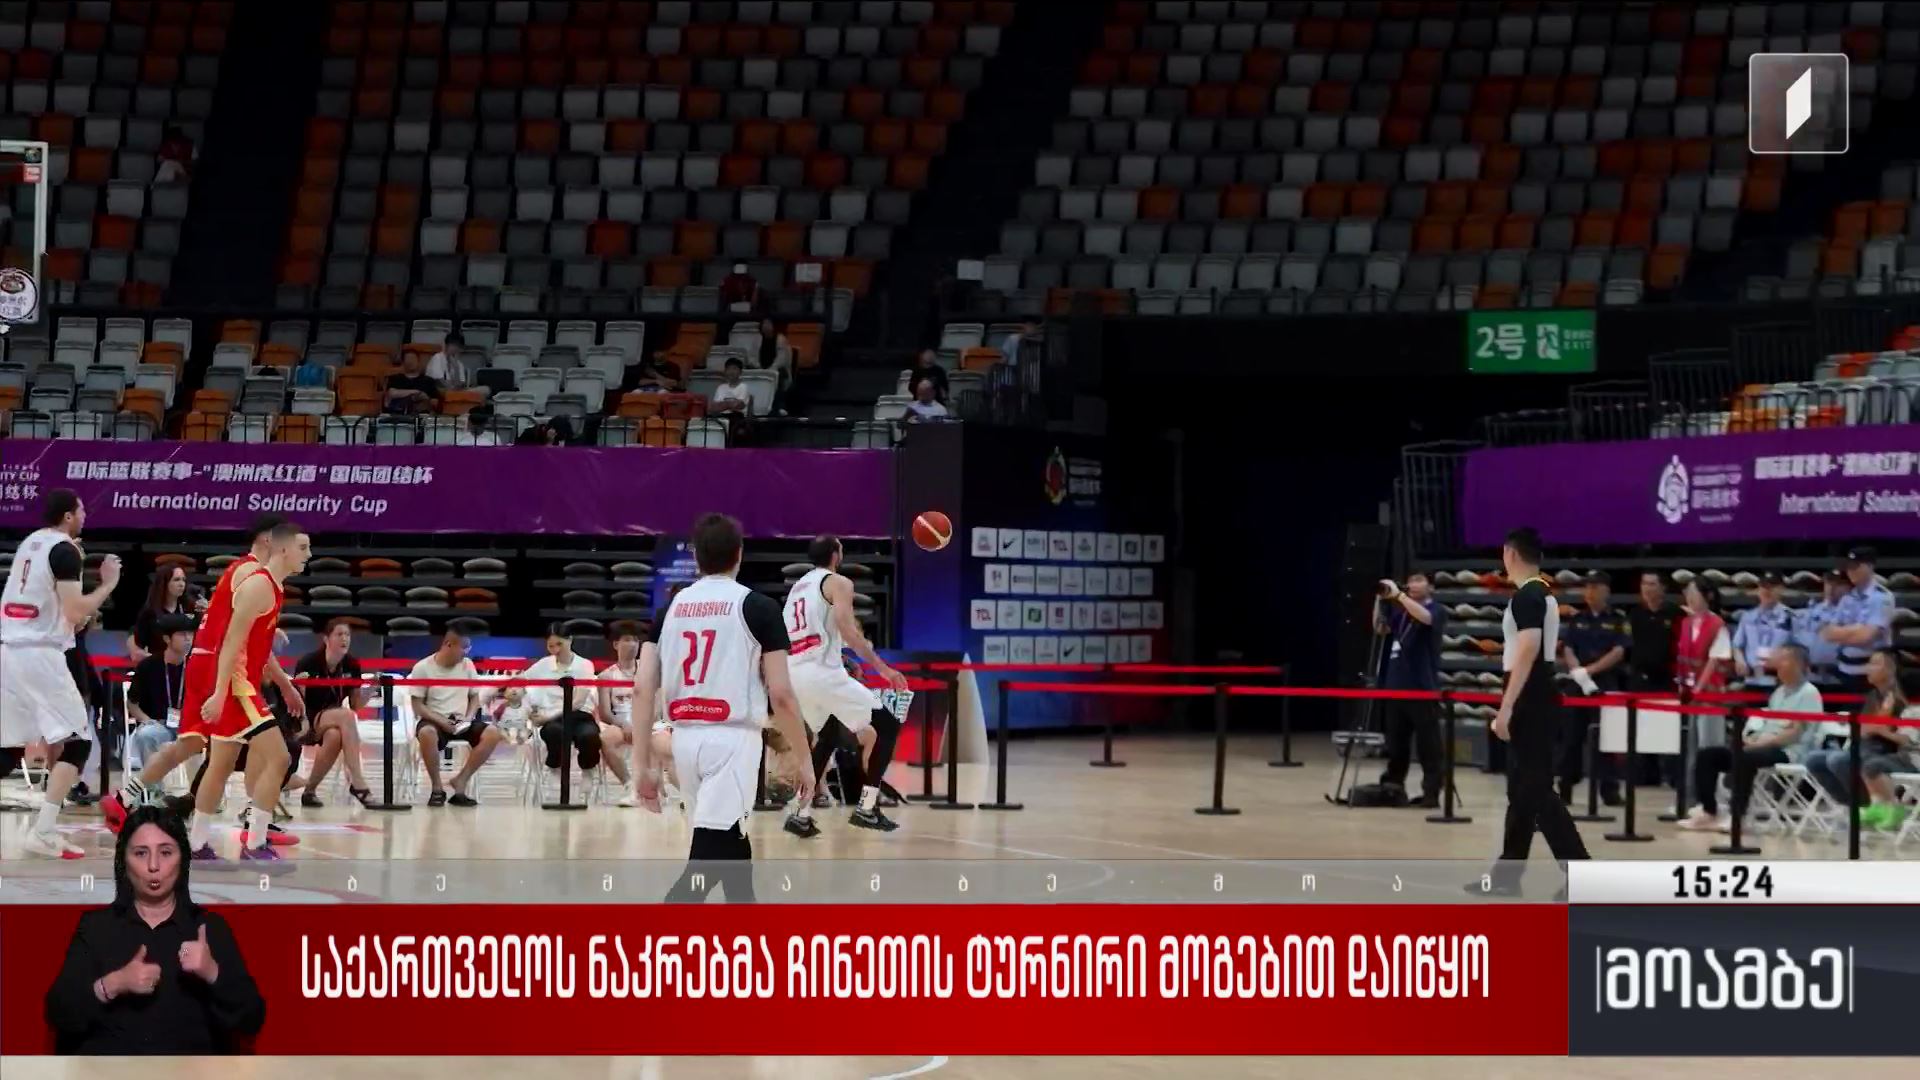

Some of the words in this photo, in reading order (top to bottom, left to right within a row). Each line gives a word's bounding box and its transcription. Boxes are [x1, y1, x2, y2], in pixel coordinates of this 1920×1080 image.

[1476, 323, 1527, 360] 2号
[19, 471, 41, 481] CUP
[112, 491, 240, 511] International
[247, 493, 342, 516] Solidarity
[350, 495, 388, 517] Cup
[682, 629, 716, 686] 27
